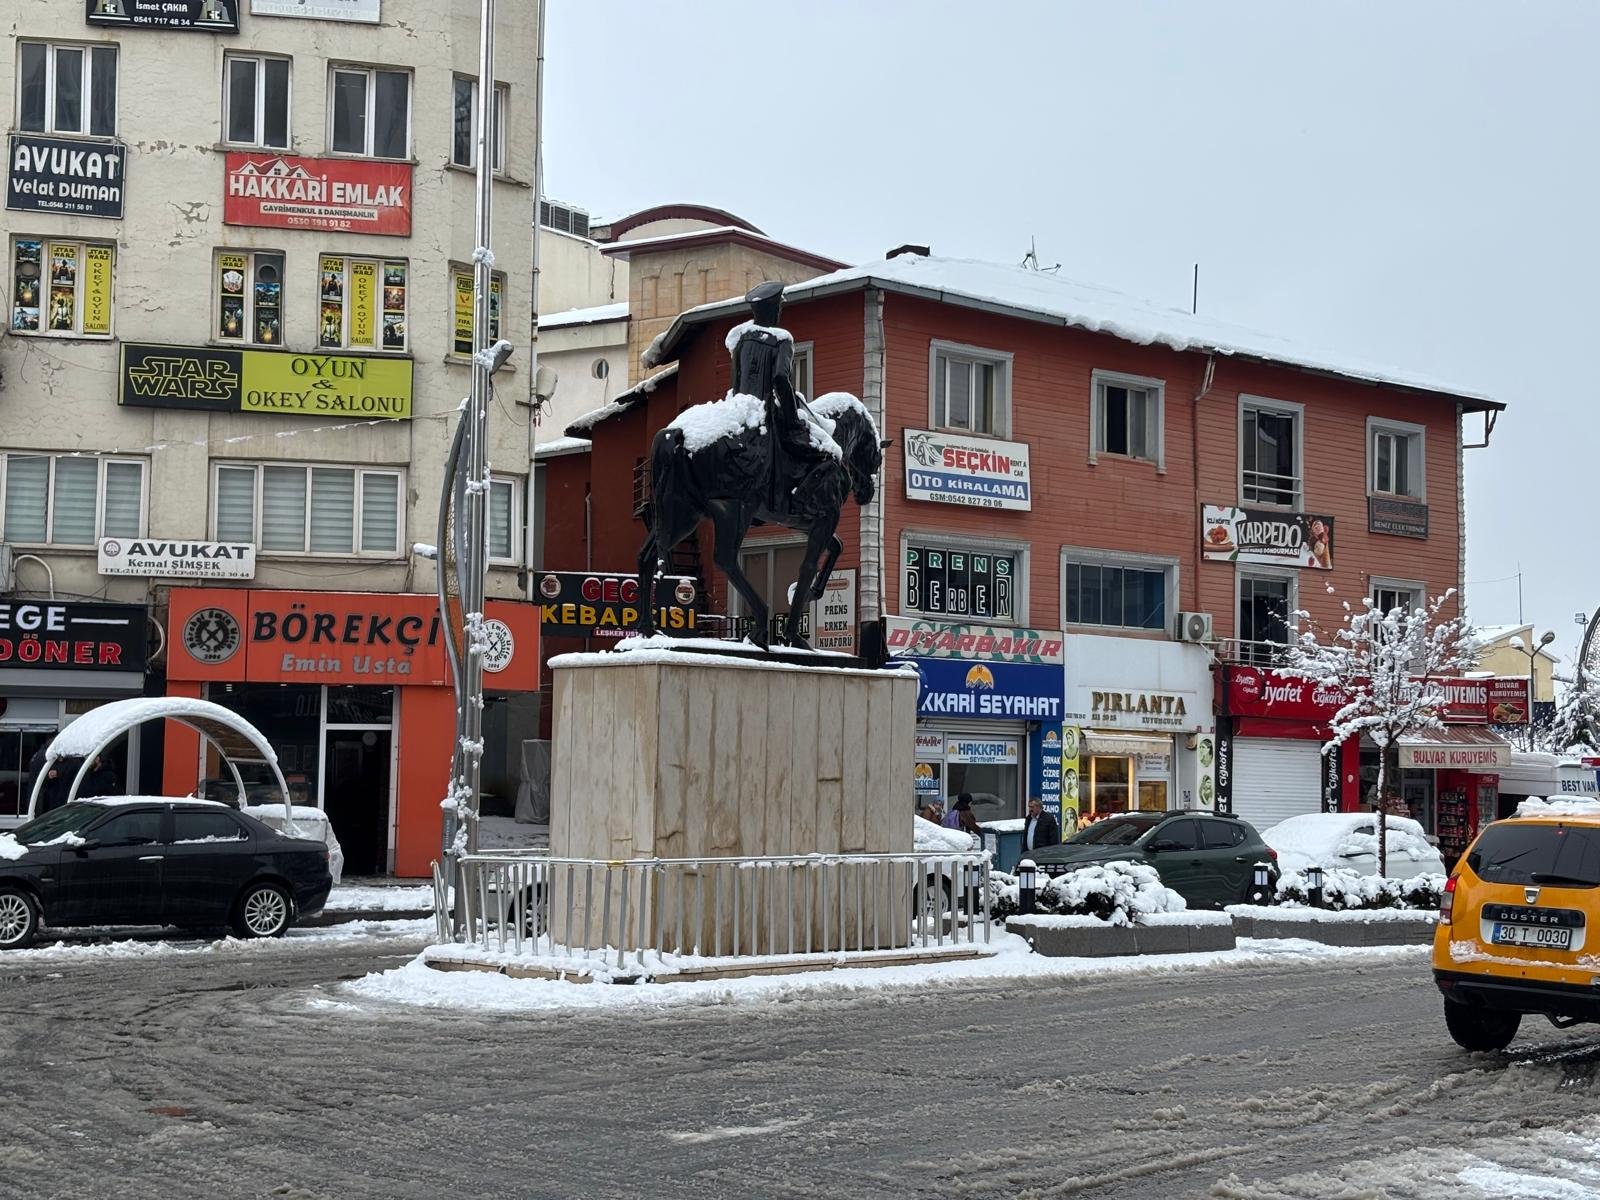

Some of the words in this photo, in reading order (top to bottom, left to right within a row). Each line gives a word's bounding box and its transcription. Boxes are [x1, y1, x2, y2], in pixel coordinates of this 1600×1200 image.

[162, 3, 188, 13] ÇAKIR
[181, 18, 190, 26] 34
[14, 144, 120, 179] AVUKAT
[12, 178, 54, 196] Velat
[230, 174, 328, 202] HAKKARİ
[332, 182, 404, 207] EMLAK
[262, 204, 317, 215] GAYRİMENKUL
[324, 208, 376, 219] DANIŞMANLIK
[329, 219, 338, 227] 91
[93, 262, 102, 286] OKEY
[358, 278, 367, 301] OKEY
[92, 296, 102, 320] OYUN
[358, 312, 367, 335] OYUN
[128, 356, 238, 380] STAR
[292, 356, 366, 380] OYUN
[129, 375, 238, 399] WARS
[312, 379, 338, 390] &
[247, 390, 311, 410] OKEY
[316, 394, 405, 413] SALONU
[943, 448, 1010, 474] SEÇKİN
[1010, 460, 1022, 468] RENT
[911, 473, 942, 488] OTO
[948, 478, 1025, 499] KİRALAMA
[930, 493, 966, 504] GSM:0542
[968, 497, 981, 505] 827
[983, 498, 992, 506] 29
[1238, 521, 1302, 548] KARPEDO
[127, 543, 250, 560] AVUKAT
[906, 550, 1010, 575] PRENS
[128, 558, 167, 568] Kemal
[171, 559, 220, 570] ŞİMŞEK
[906, 570, 1011, 616] BERBER
[541, 603, 695, 629] KEBAPISI
[825, 605, 848, 615] PRENS
[254, 604, 440, 656] BÖREKÇİ
[281, 654, 341, 672] Emin
[352, 656, 411, 675] Usta
[1092, 691, 1186, 715] PIRLANTA
[1261, 681, 1302, 706] iyafet
[980, 694, 1060, 716] SEYAHAT
[958, 742, 1007, 756] HAKKARİ
[1414, 751, 1446, 764] BULVAR
[1450, 748, 1497, 766] KURUYEMİŞ
[1043, 756, 1060, 765] ŞIRNAK
[1219, 740, 1228, 786] Çiğköfte
[1043, 767, 1060, 777] CİZRE
[1042, 779, 1060, 790] SİLOPİ
[1562, 780, 1580, 792] BEST
[1582, 780, 1596, 792] VAN
[1501, 913, 1559, 923] DUSTER
[1501, 926, 1516, 940] 30
[1522, 928, 1529, 940] T
[1537, 929, 1568, 944] 0030
